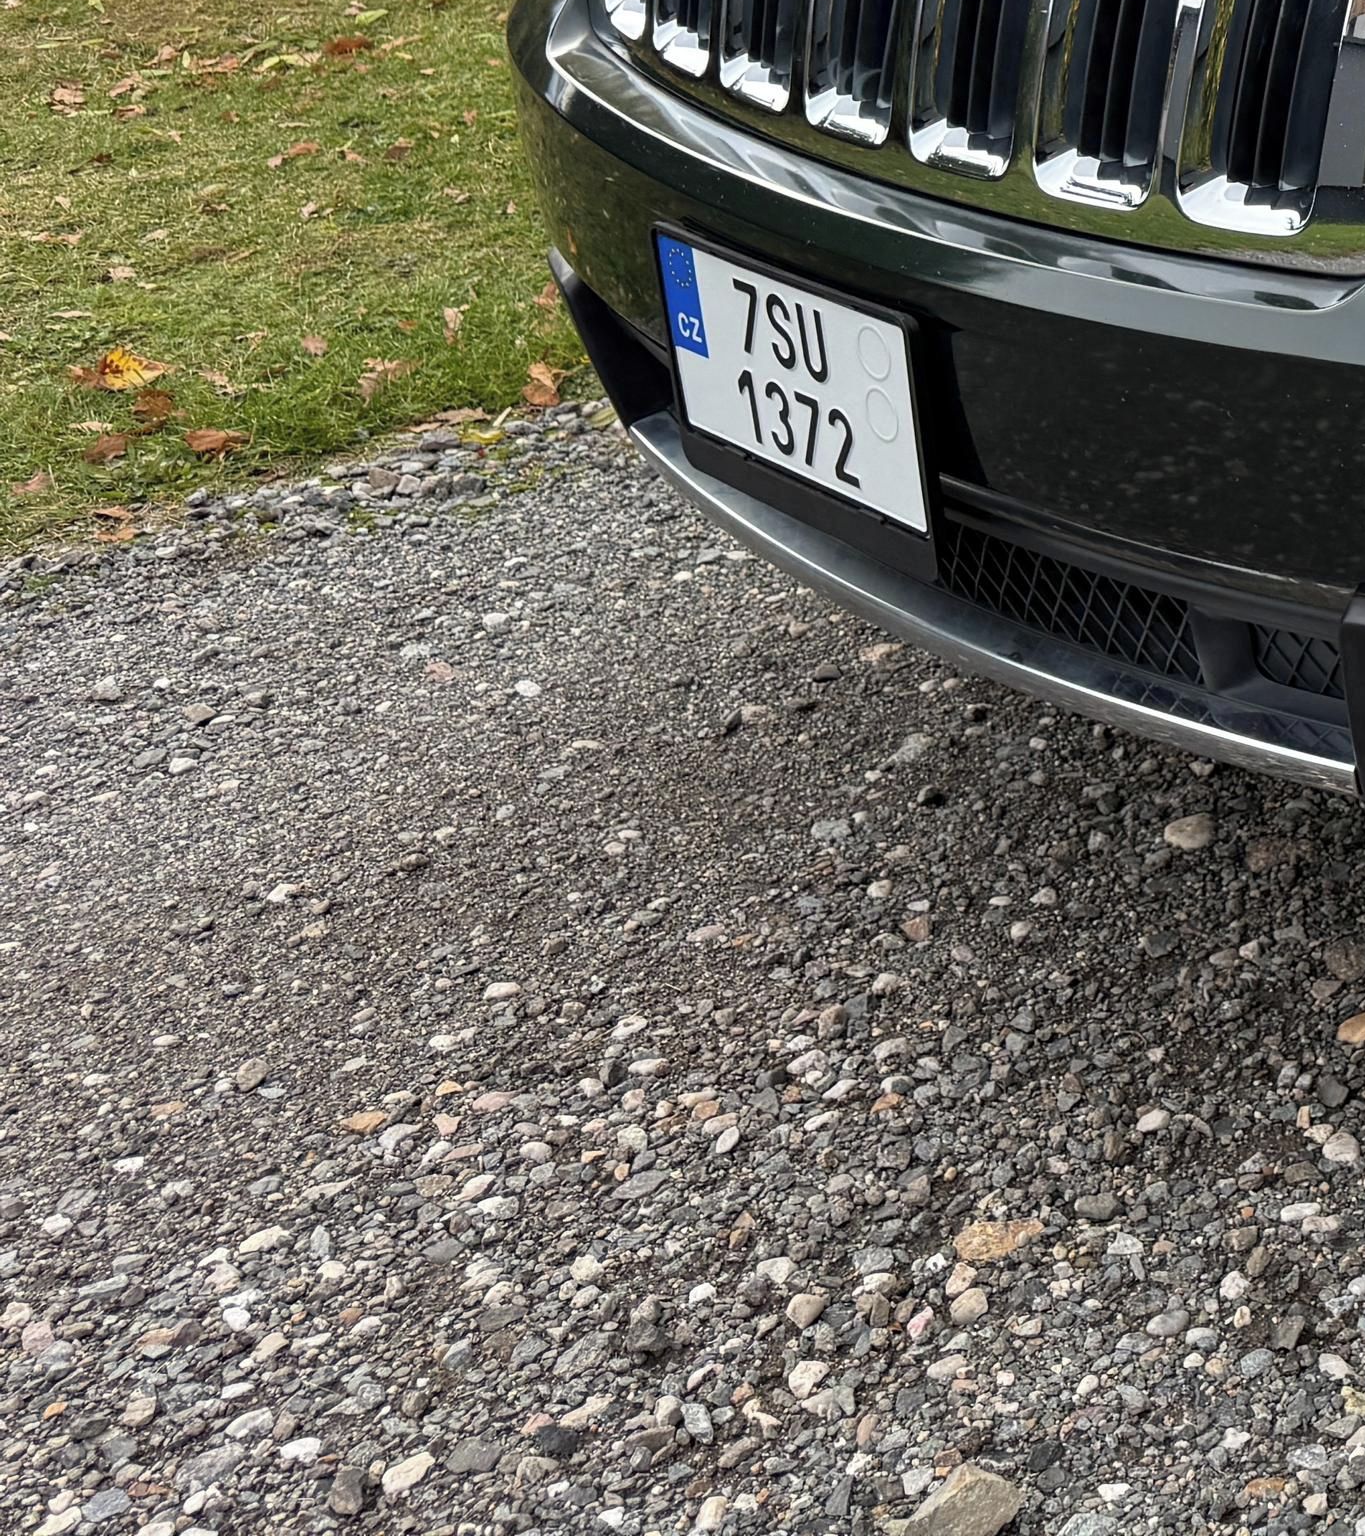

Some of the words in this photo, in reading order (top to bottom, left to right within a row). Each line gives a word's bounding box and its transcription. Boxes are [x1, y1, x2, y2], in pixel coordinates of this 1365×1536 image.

[677, 312, 703, 342] CZ
[732, 278, 828, 383] 7SU
[737, 369, 862, 490] 1372
